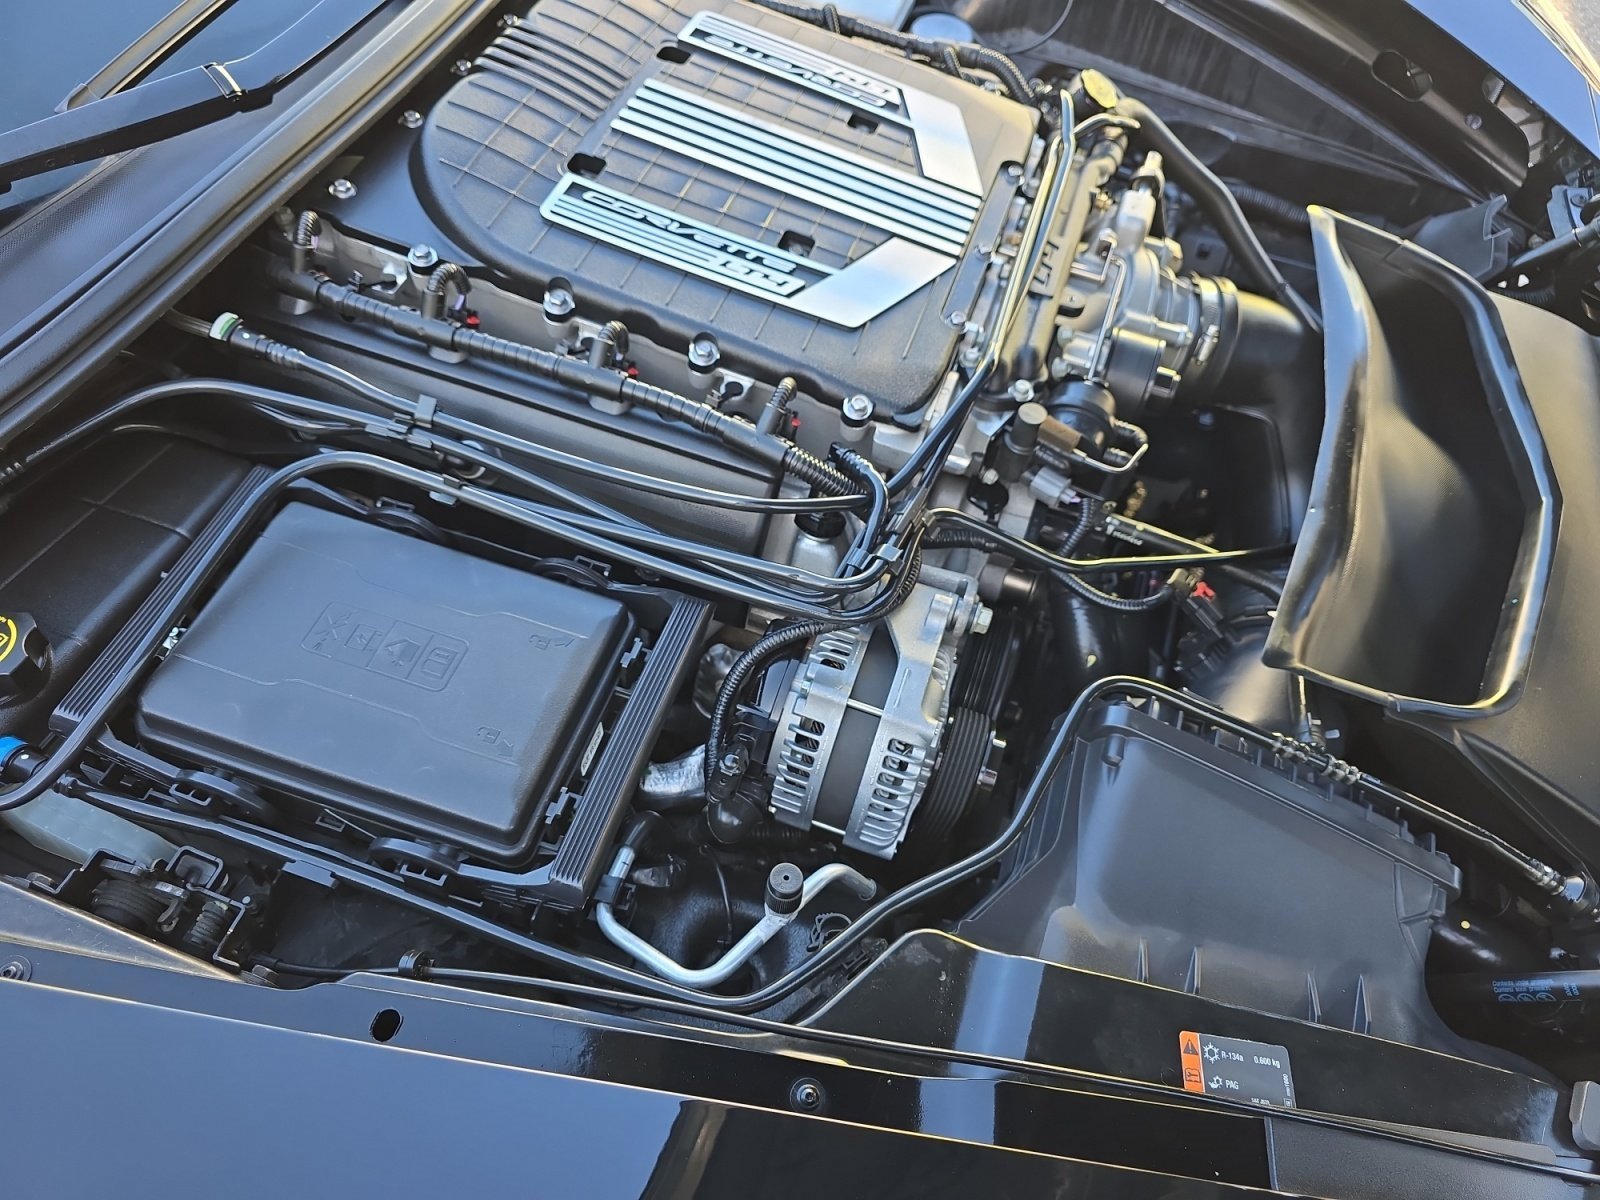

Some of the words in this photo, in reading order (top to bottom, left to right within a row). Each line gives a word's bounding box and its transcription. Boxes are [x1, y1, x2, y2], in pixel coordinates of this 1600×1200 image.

[704, 34, 887, 107] CORVETTE
[582, 190, 797, 273] CORVETTE
[1221, 1050, 1244, 1062] R-134a
[1271, 1058, 1281, 1069] kg
[1225, 1079, 1240, 1090] PAG
